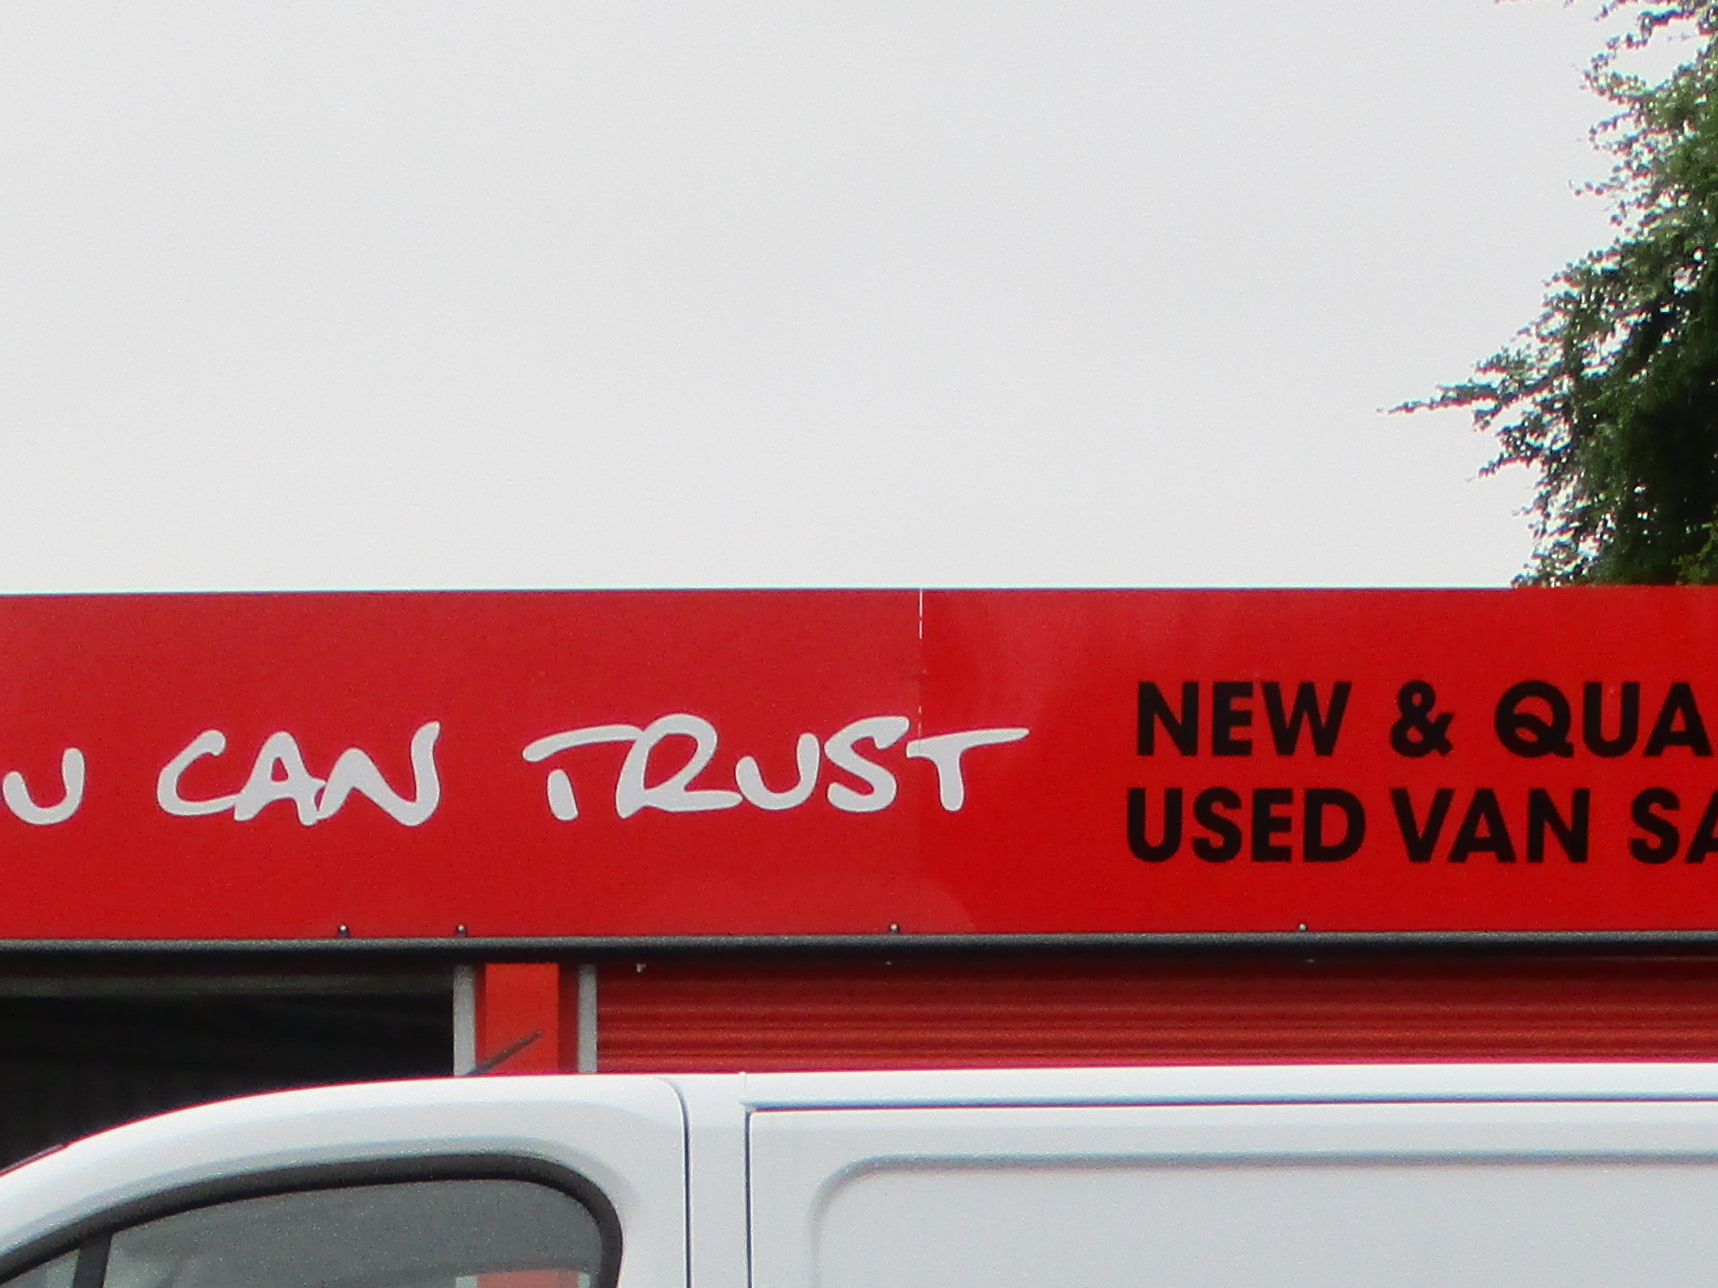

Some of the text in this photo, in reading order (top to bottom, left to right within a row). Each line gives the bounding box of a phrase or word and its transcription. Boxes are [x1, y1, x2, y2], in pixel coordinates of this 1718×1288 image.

[1137, 681, 1352, 757] NEW
[1390, 679, 1455, 759] &
[156, 720, 441, 827] CAN
[518, 712, 1030, 821] TRUST
[1126, 787, 1367, 864] USED
[1390, 787, 1591, 864] VAN
